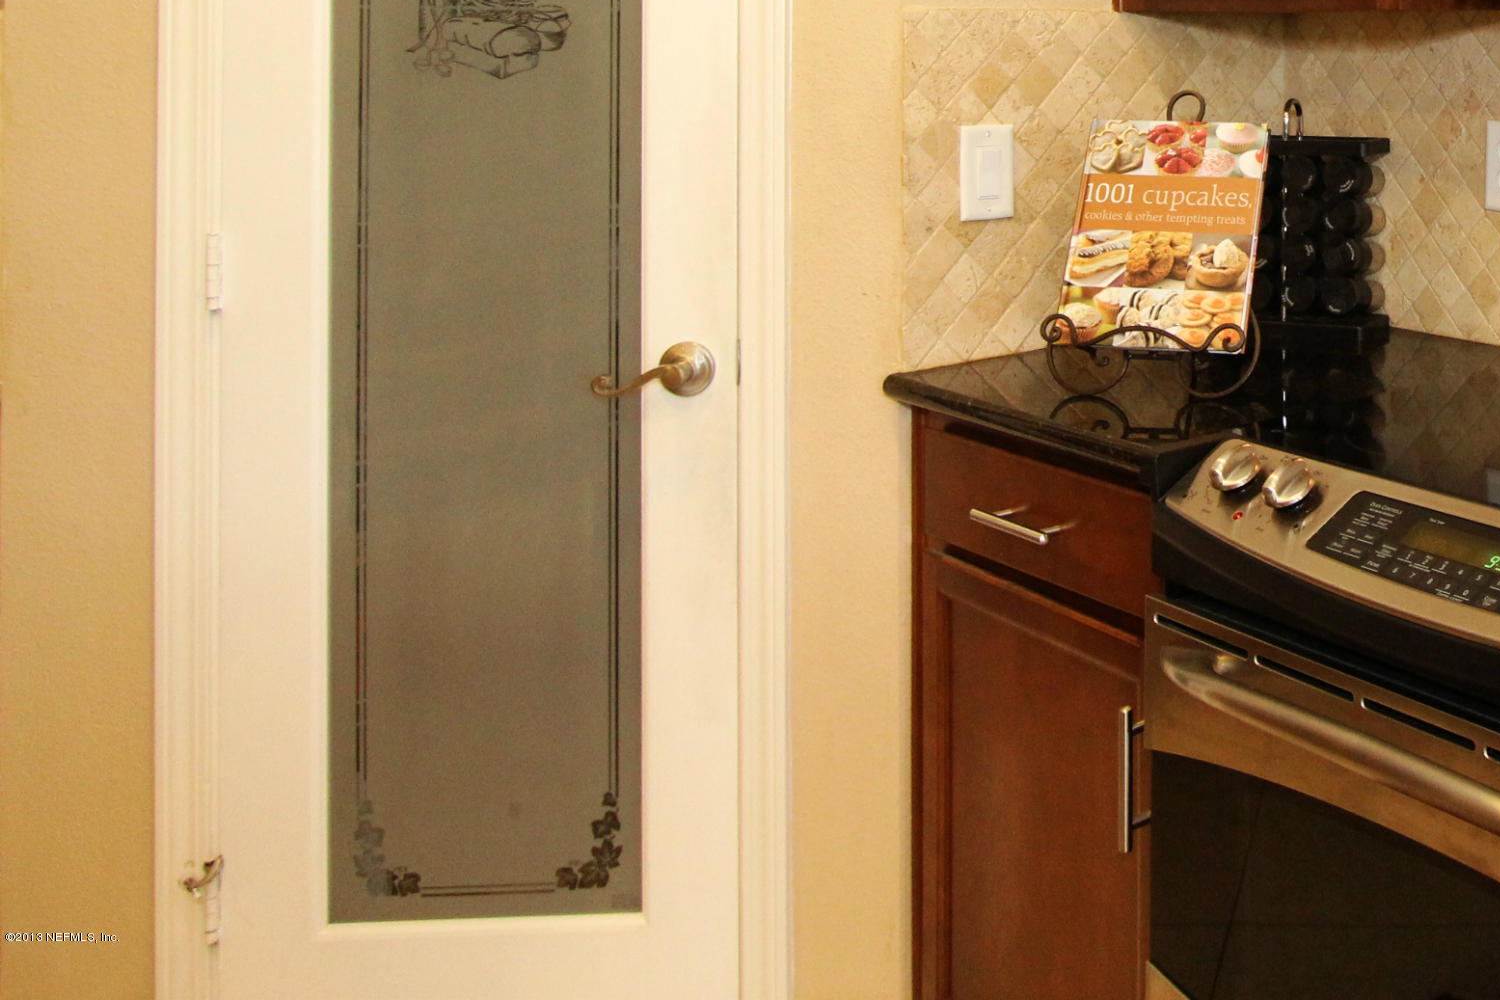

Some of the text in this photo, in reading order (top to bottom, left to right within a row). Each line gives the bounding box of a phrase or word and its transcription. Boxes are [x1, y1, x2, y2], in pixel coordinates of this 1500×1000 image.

[1085, 182, 1135, 204] 1001
[1084, 210, 1247, 225] cookies & other tempting treats
